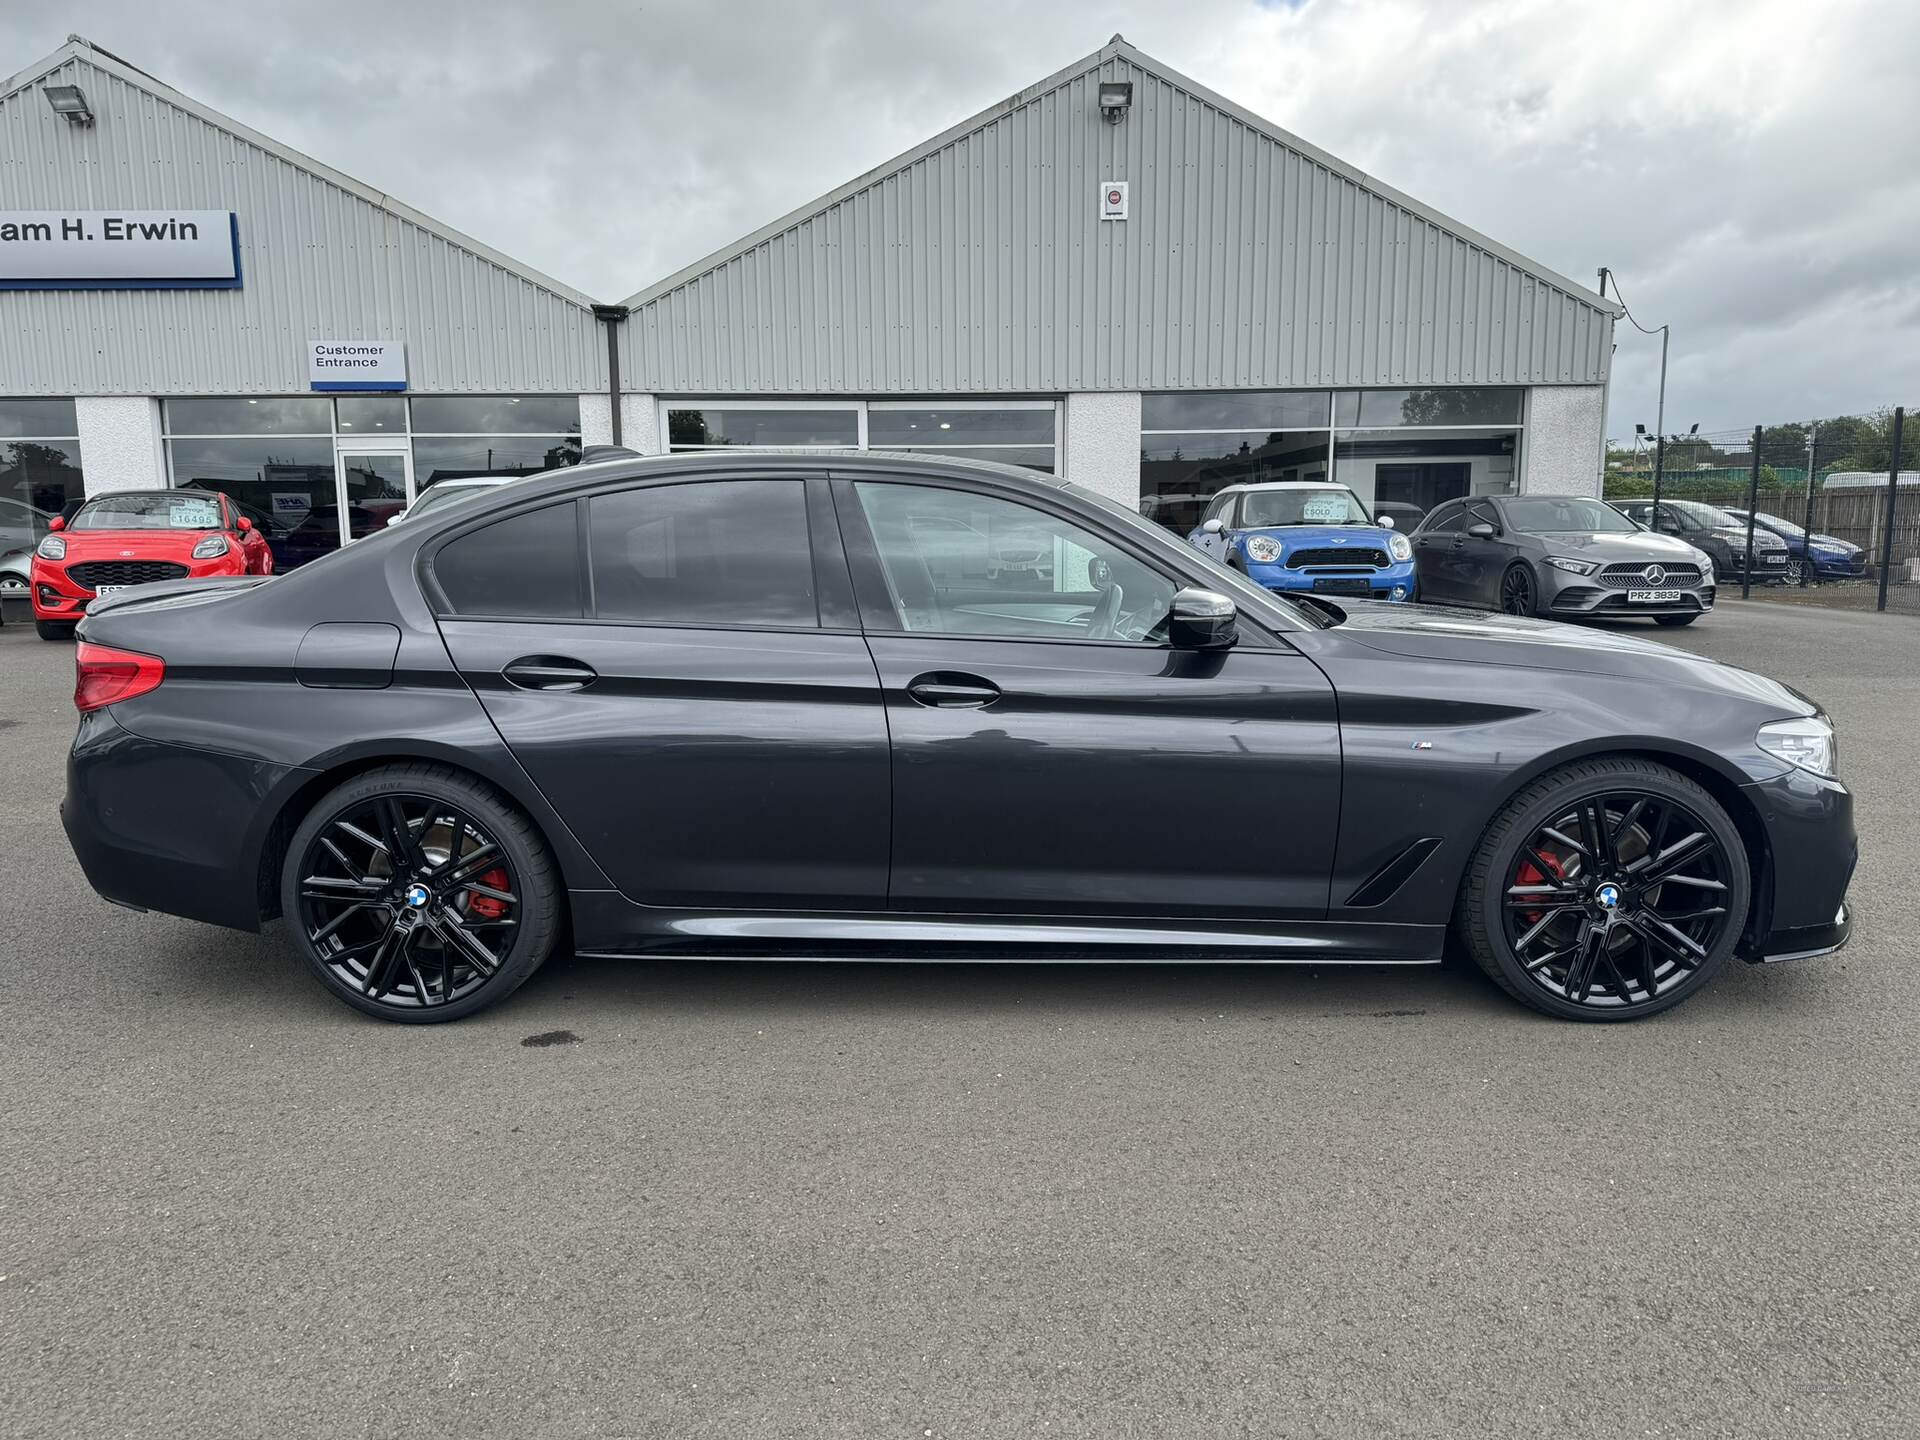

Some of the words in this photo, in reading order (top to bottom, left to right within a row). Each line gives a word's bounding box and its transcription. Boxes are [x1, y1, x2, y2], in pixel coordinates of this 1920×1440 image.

[1, 222, 52, 241] am
[61, 218, 94, 241] H.
[103, 218, 198, 241] Erwin
[315, 345, 384, 355] Customer
[316, 357, 378, 367] Entrance
[1630, 591, 1652, 600] PRZ
[1653, 590, 1680, 599] 3832
